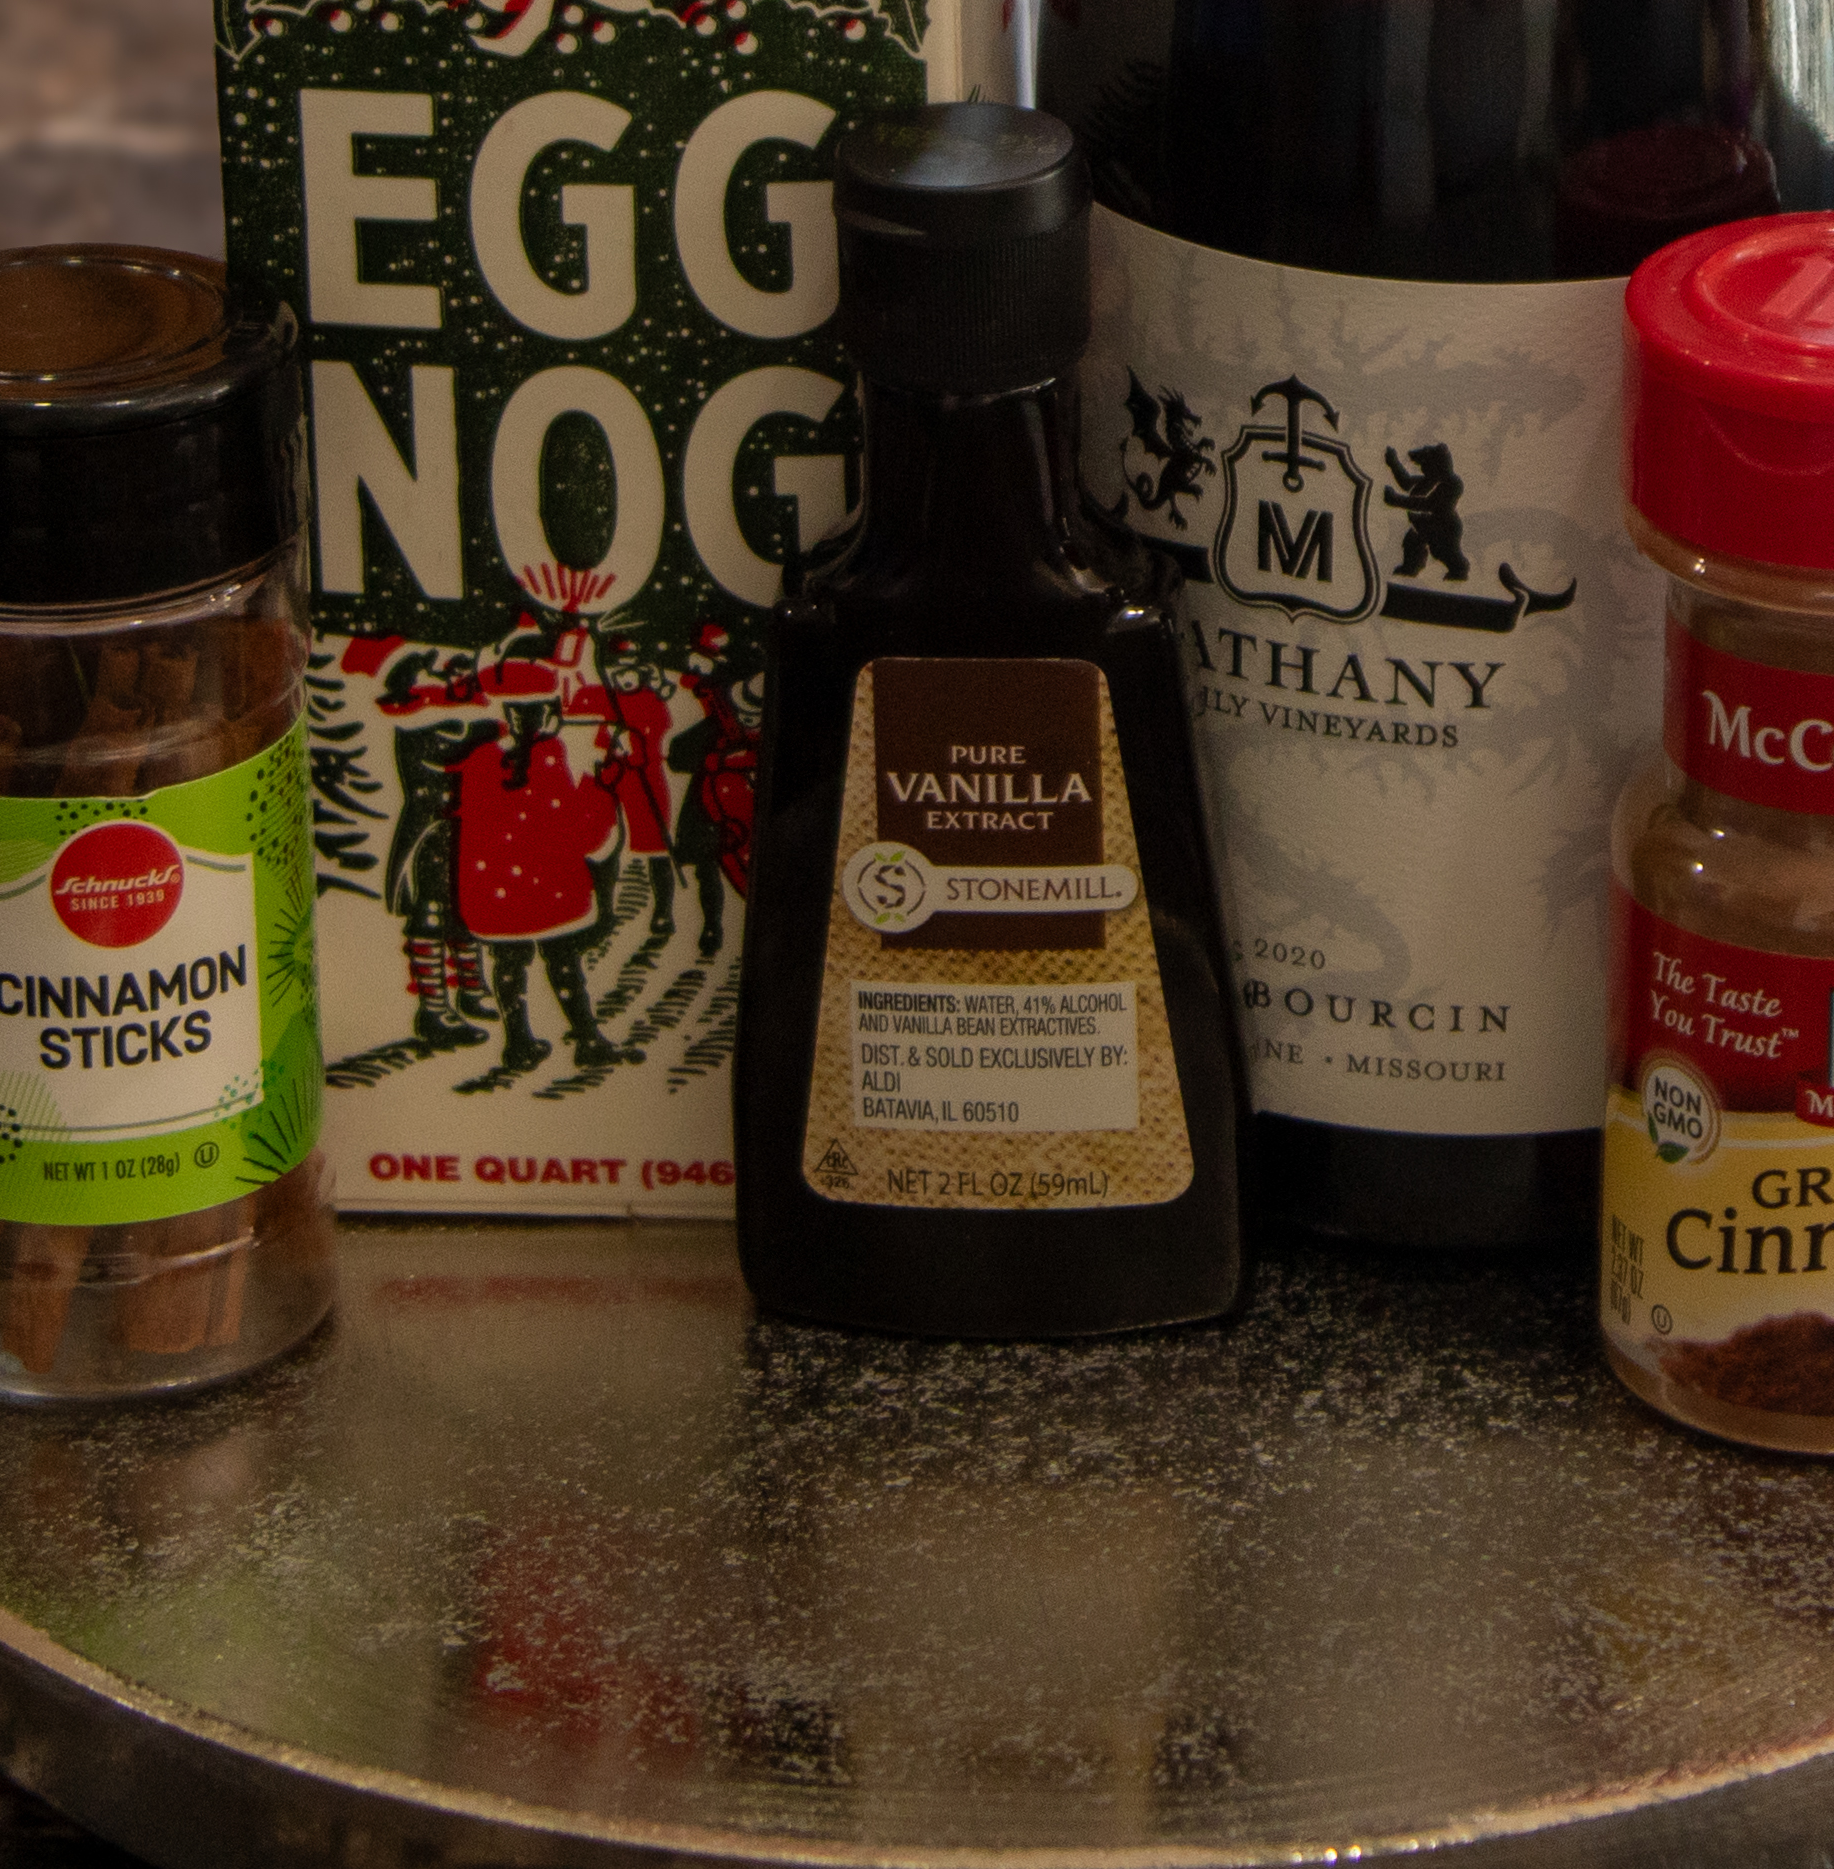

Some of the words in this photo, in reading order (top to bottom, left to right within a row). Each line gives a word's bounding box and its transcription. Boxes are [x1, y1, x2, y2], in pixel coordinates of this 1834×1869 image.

[300, 89, 841, 340] EGG
[311, 359, 847, 612] NOG
[1260, 700, 1459, 749] VINEYARDS
[950, 745, 1028, 765] PURE
[885, 771, 1093, 805] VANILLA
[926, 811, 1055, 831] EXTRACT
[54, 863, 180, 895] Schnucks
[70, 895, 120, 912] SINCE
[127, 889, 166, 908] 1939
[1254, 938, 1326, 970] 2020
[1653, 952, 1695, 996] The
[1702, 973, 1783, 1018] Taste
[858, 991, 961, 1014] INGREDIENTS:
[965, 995, 1019, 1017] WATER,
[1023, 996, 1056, 1015] 41%
[1059, 992, 1128, 1013] ALCOHOL
[1650, 989, 1695, 1037] You
[39, 1009, 213, 1070] STICKS
[858, 1016, 889, 1034] AND
[892, 1017, 953, 1035] VANILLA
[956, 1017, 996, 1036] BEAN
[1000, 1016, 1101, 1036] EXTRACTIVES.
[861, 1043, 905, 1066] DIST.
[908, 1047, 922, 1067] &
[926, 1046, 973, 1068] SOLD
[980, 1046, 1095, 1069] EXCLUSIVELY
[1099, 1045, 1128, 1067] BY:
[1346, 1053, 1507, 1081] MISSOURI
[861, 1071, 901, 1093] ALDI
[1654, 1076, 1703, 1118] NON
[862, 1097, 940, 1123] BATAVIA,
[942, 1100, 958, 1122] IL
[963, 1101, 1020, 1123] 60510
[1653, 1102, 1704, 1140] GMO
[43, 1161, 70, 1182] NET
[73, 1160, 97, 1182] WT
[101, 1160, 109, 1181] 1
[115, 1157, 136, 1180] OZ
[140, 1151, 180, 1179] (28g)
[369, 1153, 462, 1181] ONE
[473, 1155, 627, 1186] QUART
[886, 1169, 932, 1196] NET
[938, 1171, 952, 1195] 2
[958, 1171, 984, 1196] FL
[989, 1172, 1024, 1197] OZ
[1029, 1170, 1109, 1198] (59mL)
